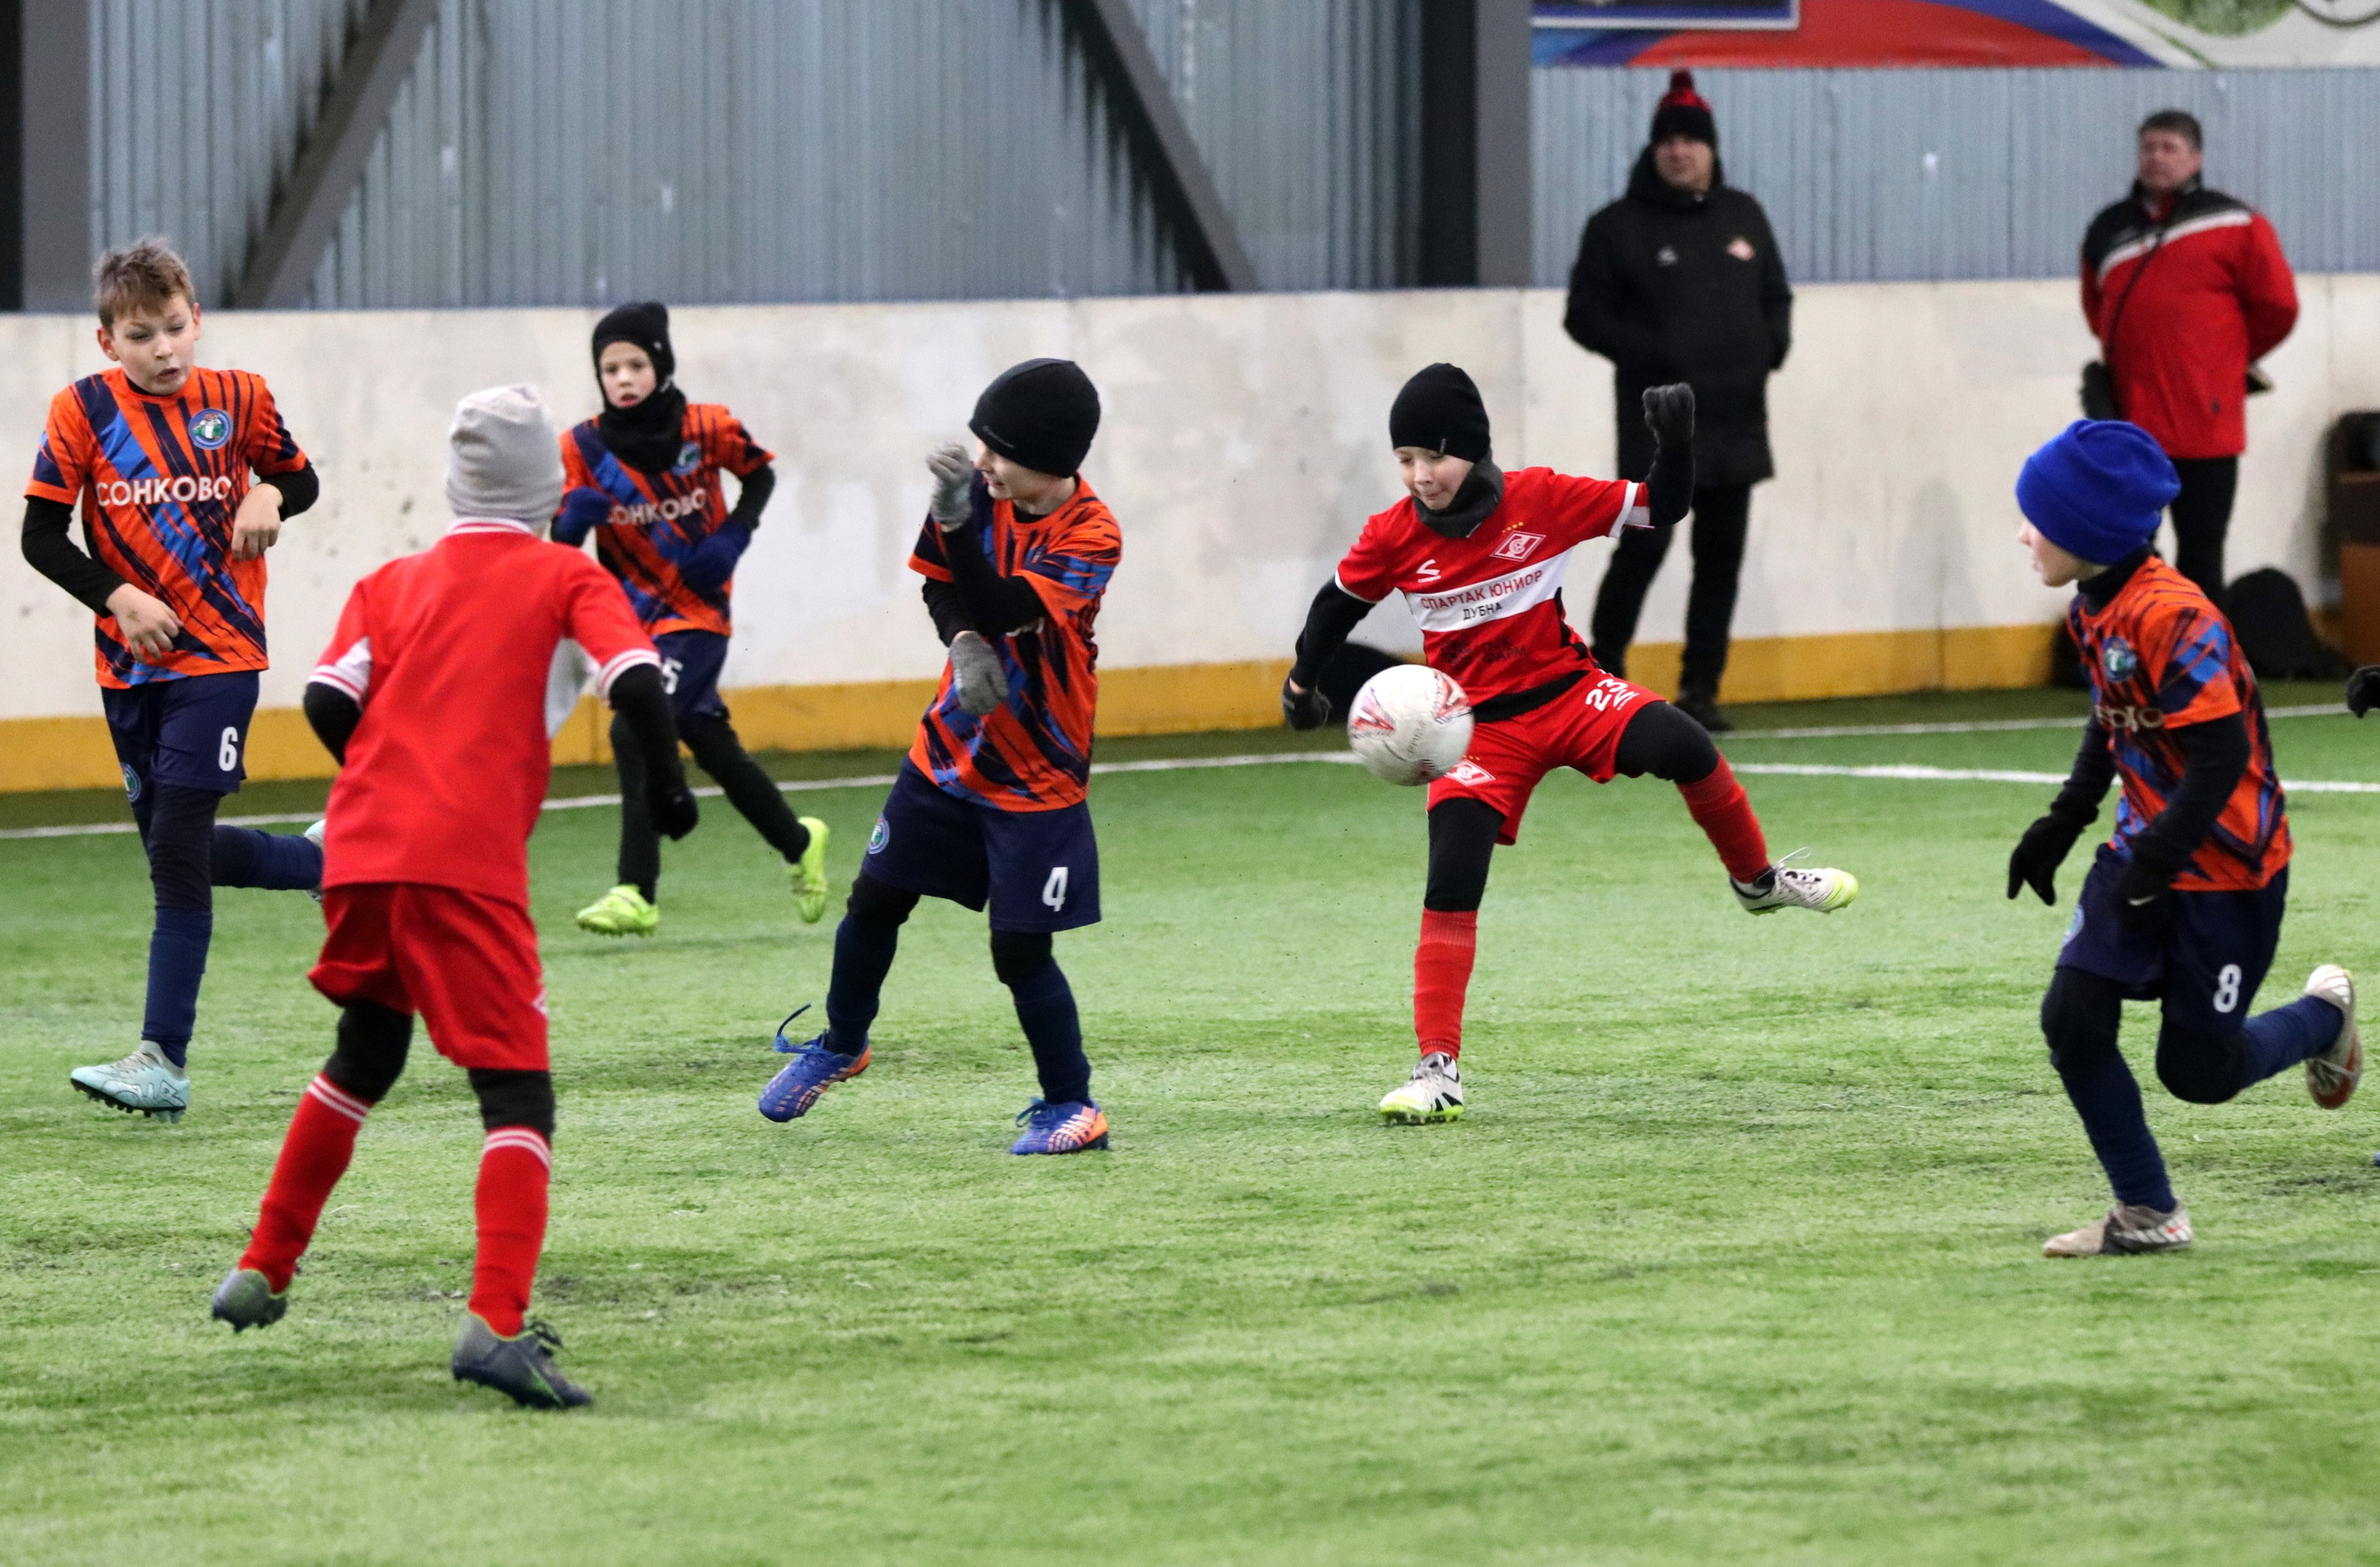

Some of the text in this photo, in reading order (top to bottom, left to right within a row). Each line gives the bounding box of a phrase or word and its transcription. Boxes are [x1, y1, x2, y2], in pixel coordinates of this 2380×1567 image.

[97, 476, 231, 507] СОНКОВО
[607, 487, 707, 526] ОНКОВО
[1421, 570, 1542, 610] СПАРТАК ЮНИОР
[1462, 602, 1502, 621] ДУБНА
[661, 656, 683, 694] 5
[1584, 678, 1628, 712] 23
[218, 727, 238, 771] 6
[1042, 867, 1068, 912] 4
[2214, 964, 2241, 1013] 8
